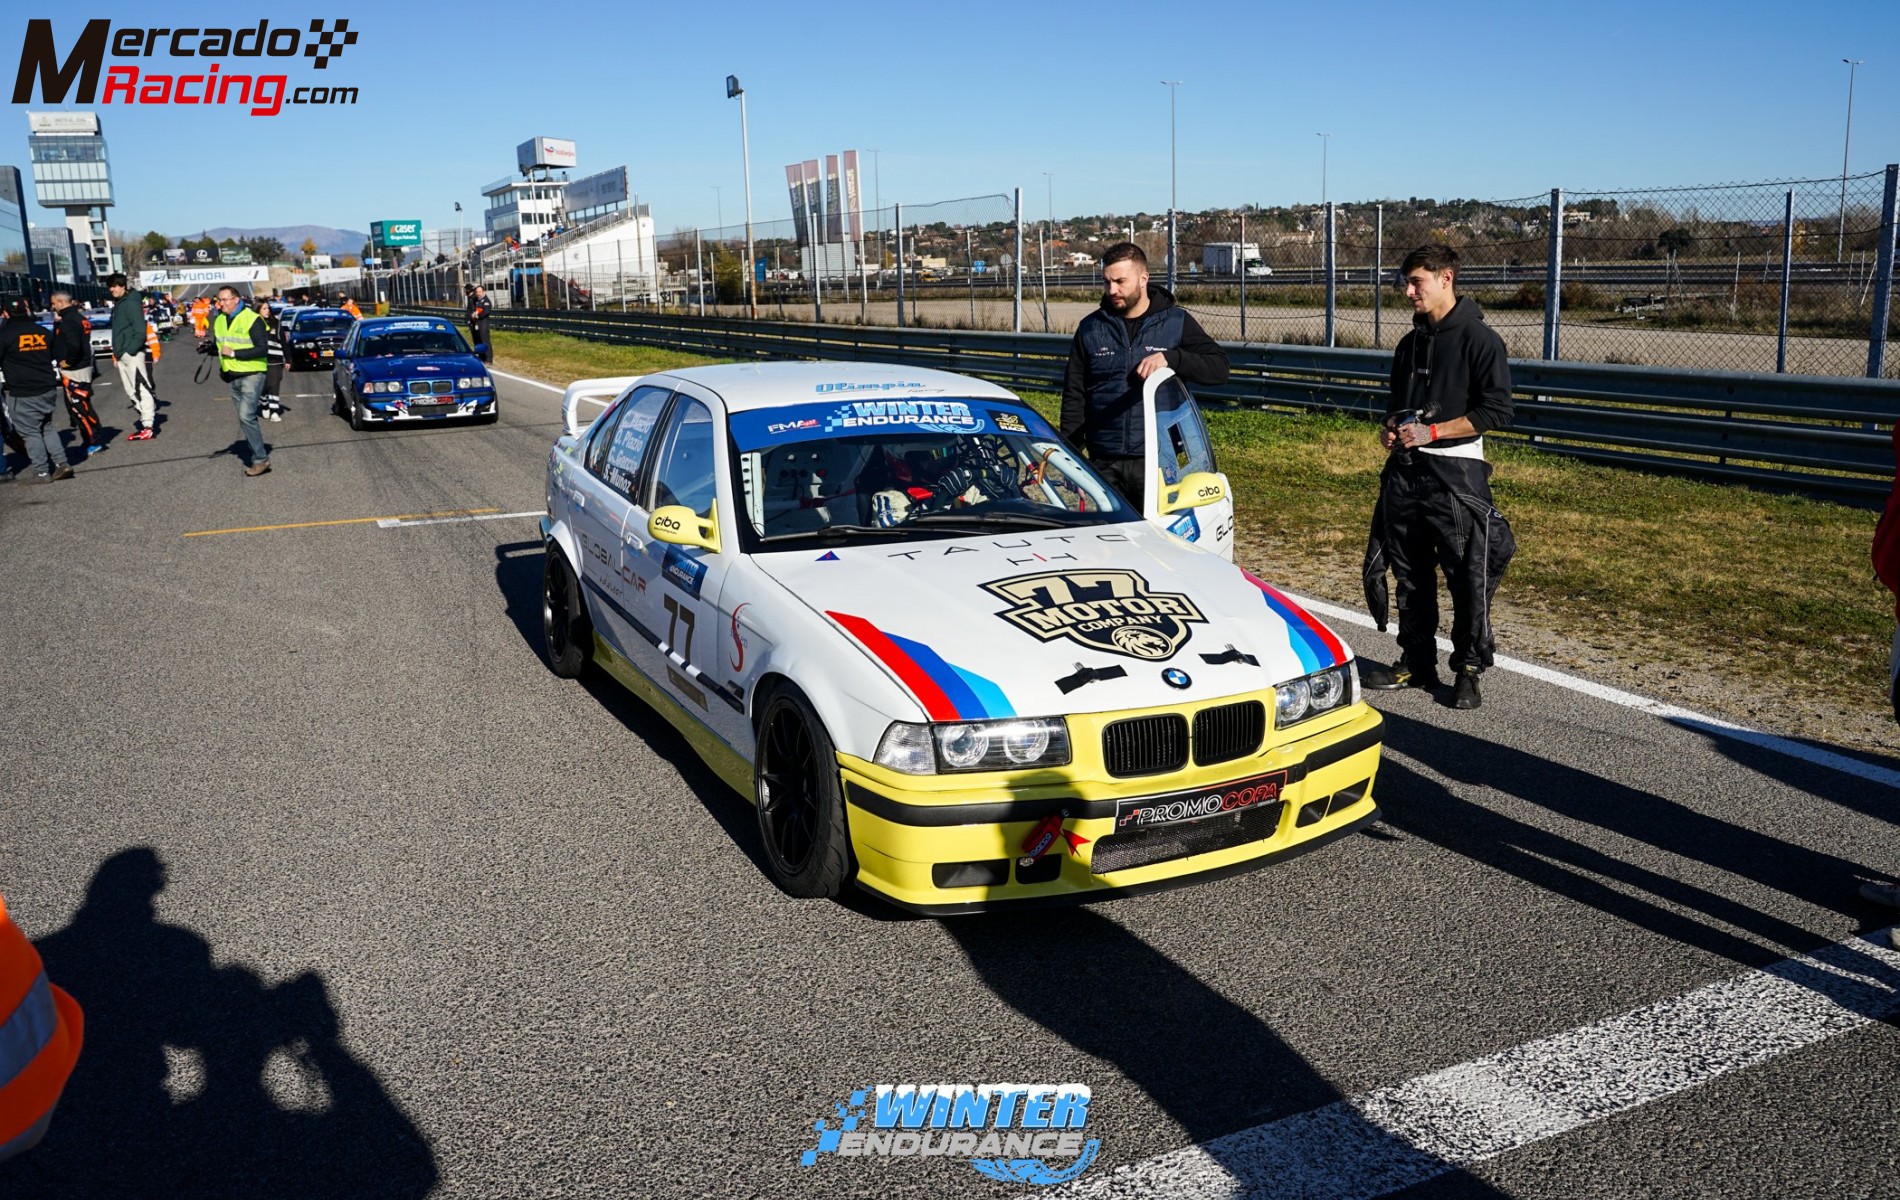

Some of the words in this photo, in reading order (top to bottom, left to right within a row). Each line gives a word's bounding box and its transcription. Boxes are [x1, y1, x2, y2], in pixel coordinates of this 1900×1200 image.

[395, 223, 416, 234] caser
[19, 334, 47, 348] RX
[815, 381, 926, 392] Olimpia
[852, 401, 970, 417] WINTER
[843, 415, 974, 428] ENDURANCE
[1198, 486, 1221, 498] ciba
[654, 516, 681, 530] ciba
[1001, 573, 1136, 606] 77
[1020, 597, 1189, 631] MOTOR
[664, 592, 695, 662] 77
[1077, 615, 1163, 632] COMPANY
[1137, 782, 1277, 826] PROMOCOPA
